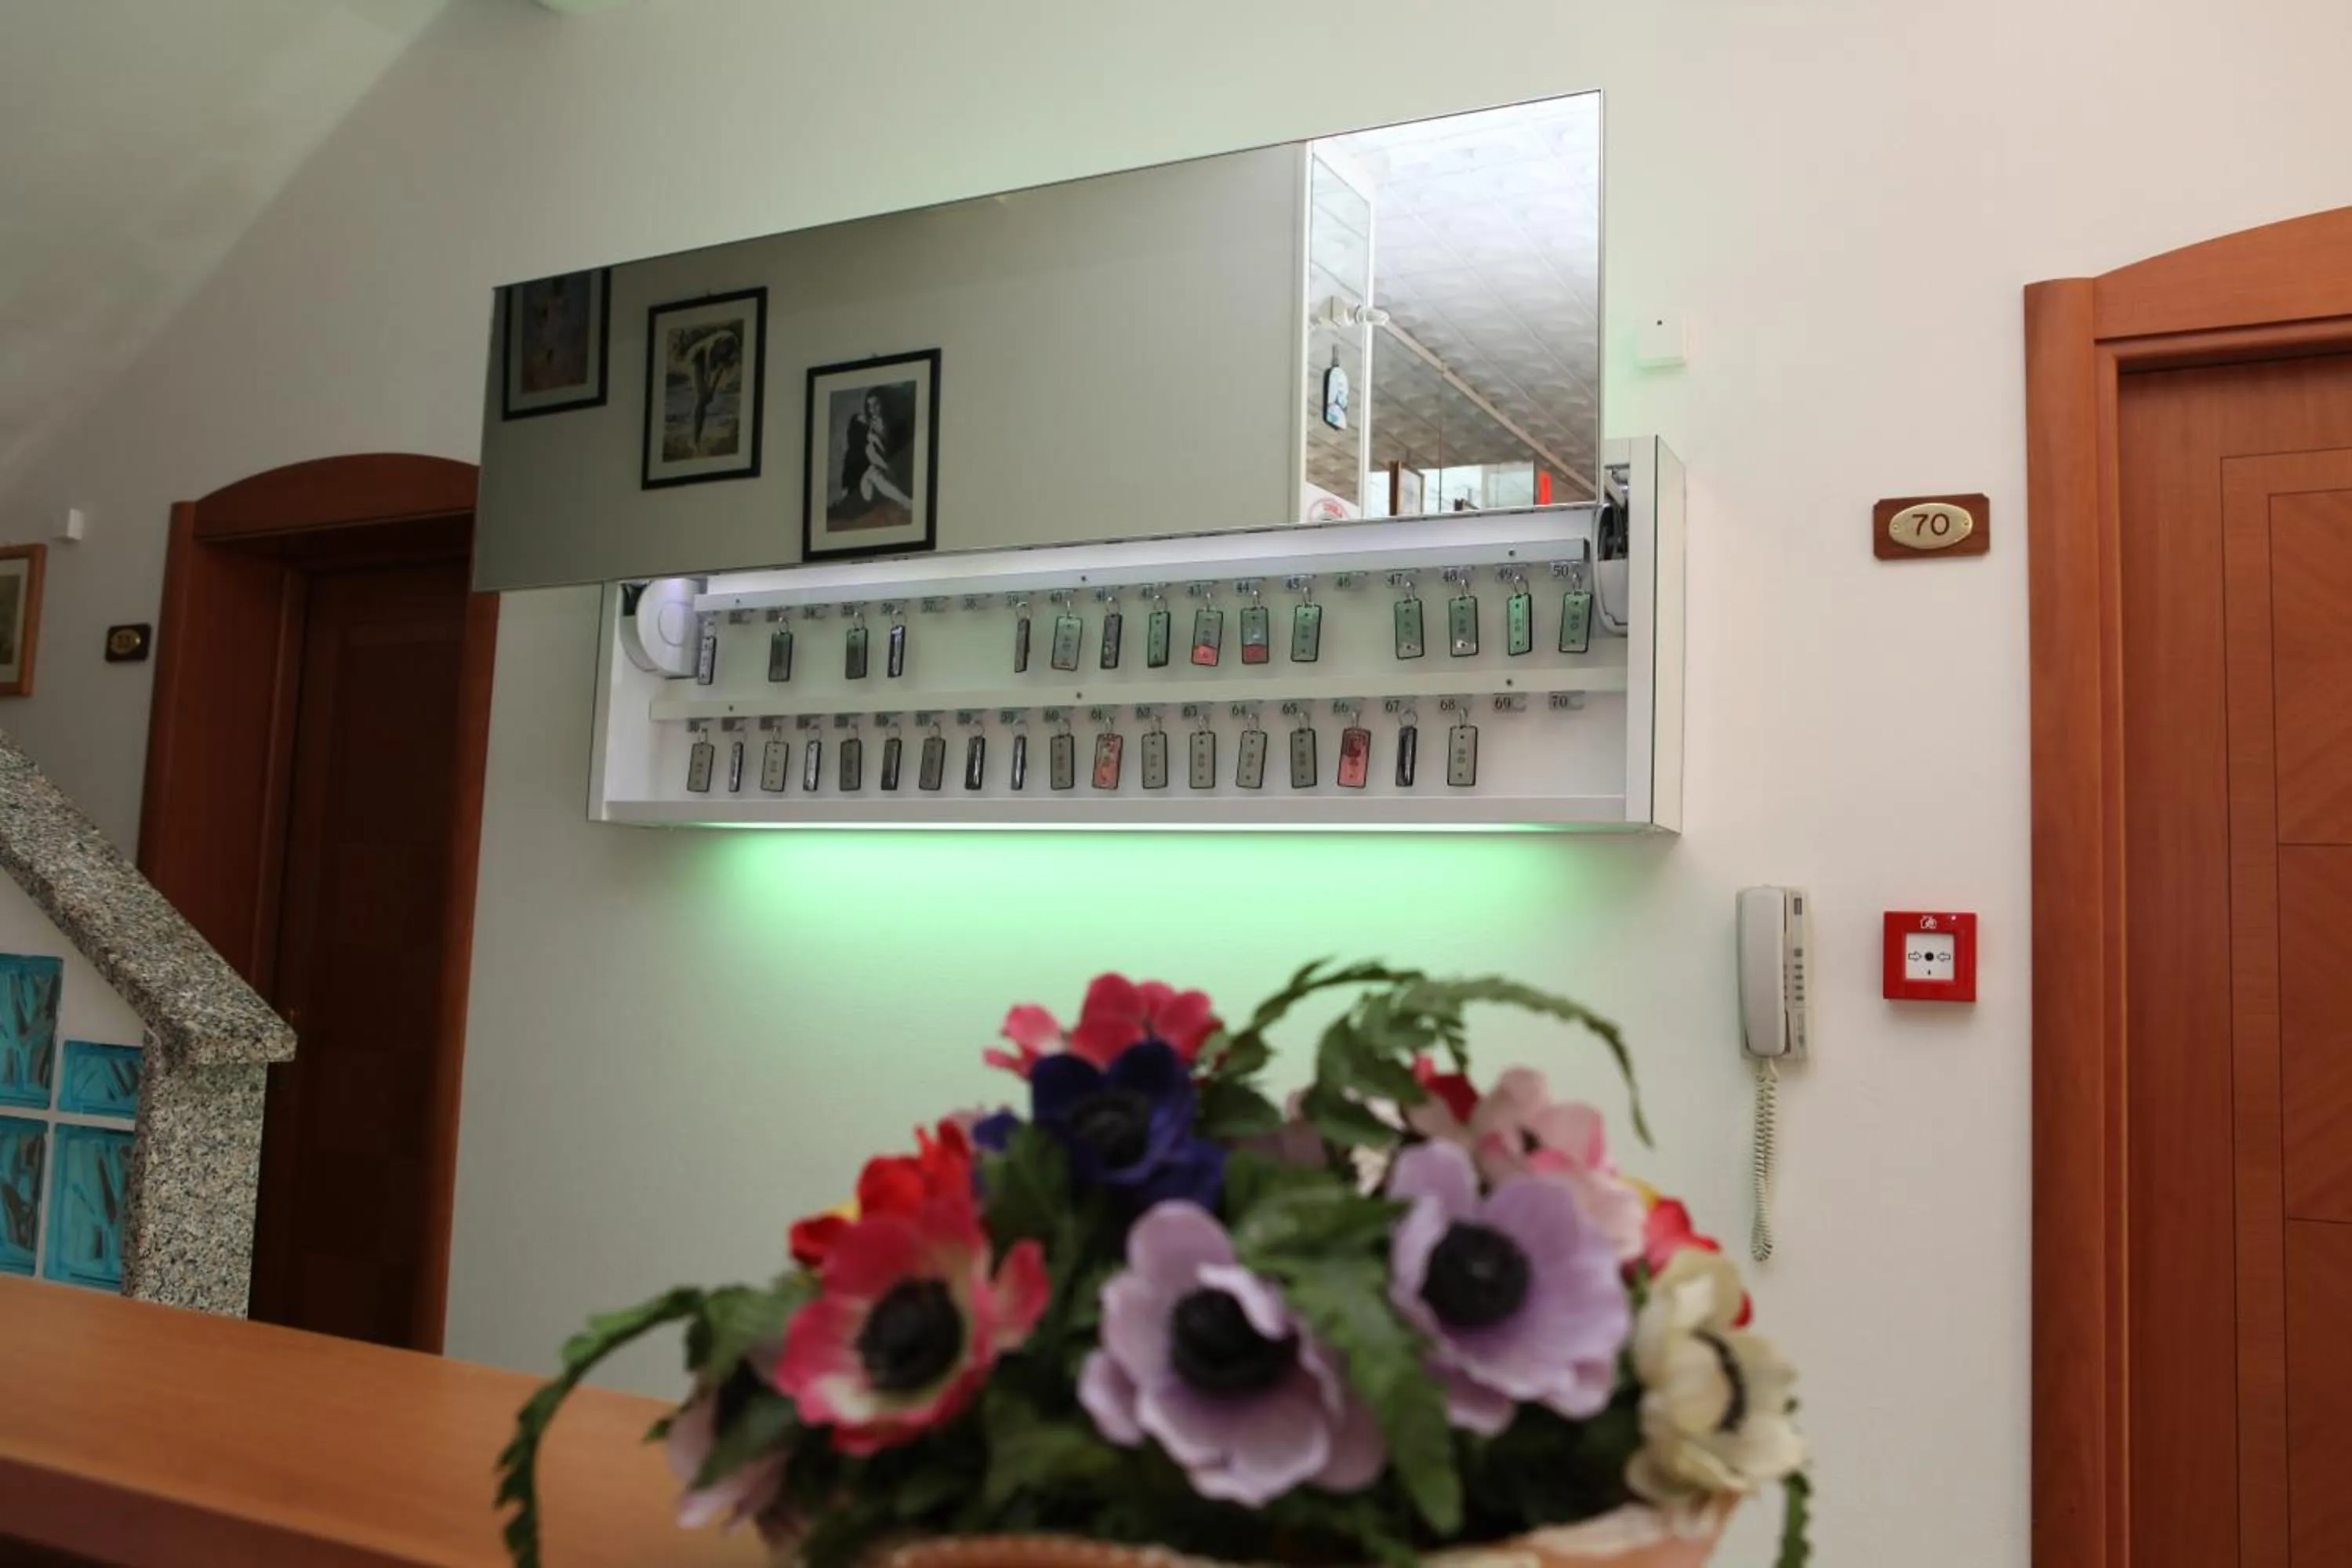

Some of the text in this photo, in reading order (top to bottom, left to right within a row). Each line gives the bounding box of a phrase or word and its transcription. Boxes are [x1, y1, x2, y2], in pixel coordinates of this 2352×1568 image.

[1912, 513, 1950, 536] 70
[1443, 569, 1457, 583] 48
[1497, 568, 1513, 580] 49
[1552, 564, 1569, 578] 50
[1287, 577, 1300, 590] 45
[1387, 572, 1403, 585] 47
[1282, 702, 1298, 714] 65
[1333, 701, 1349, 713] 66
[1385, 699, 1401, 713] 67
[1439, 698, 1456, 711] 68
[1494, 696, 1512, 710] 69
[1552, 695, 1568, 708] 70
[1232, 704, 1246, 715] 64
